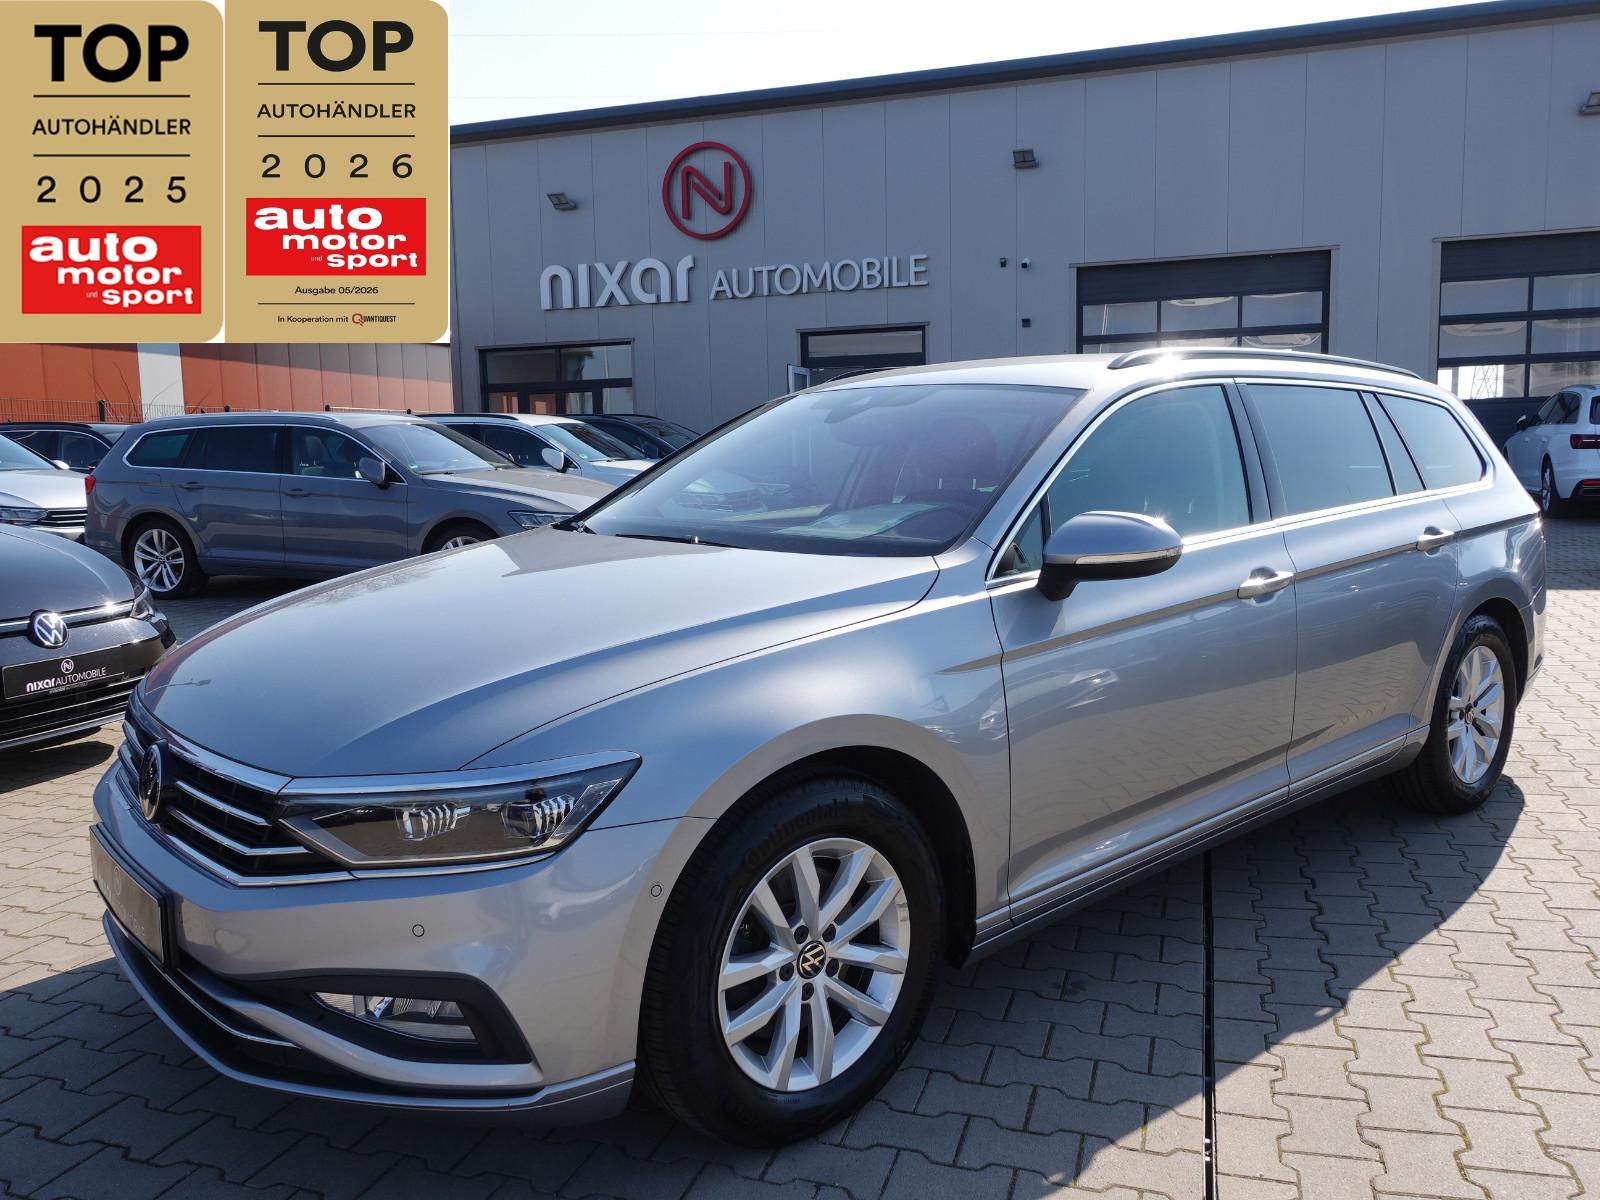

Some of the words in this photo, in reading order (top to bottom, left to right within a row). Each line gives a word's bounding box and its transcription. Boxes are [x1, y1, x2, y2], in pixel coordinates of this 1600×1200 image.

[539, 255, 696, 310] nixar
[710, 253, 930, 300] AUTOMOBILE
[56, 667, 106, 686] AUTOMOBILE
